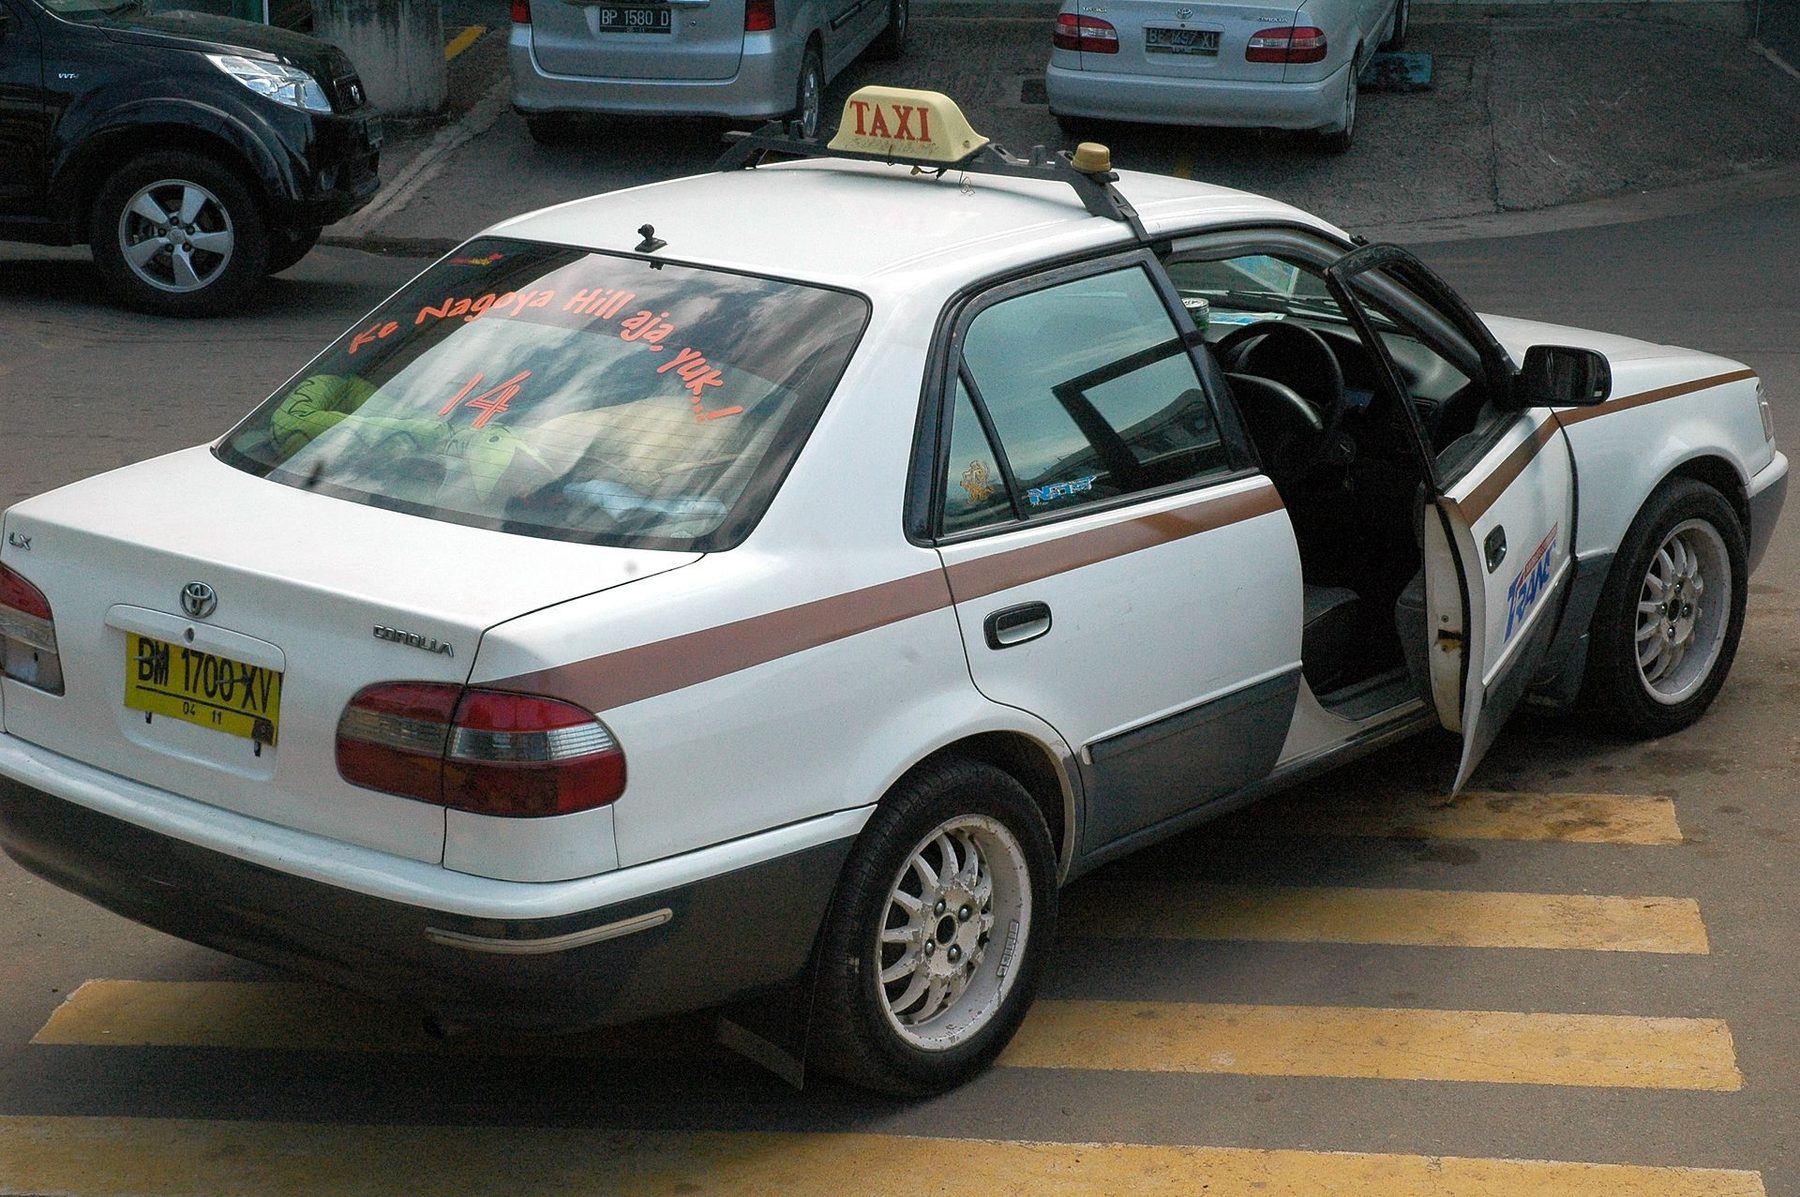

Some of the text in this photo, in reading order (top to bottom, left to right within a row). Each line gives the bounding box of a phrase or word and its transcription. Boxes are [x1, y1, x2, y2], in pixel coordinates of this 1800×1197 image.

[601, 9, 669, 26] BP 1580 D
[849, 100, 932, 143] TAXI
[349, 321, 399, 354] Ke
[414, 289, 555, 325] Nagoya
[562, 287, 635, 320] Hill
[438, 368, 533, 430] 14
[8, 531, 32, 551] LX
[373, 624, 455, 657] COROLLA
[137, 636, 273, 714] BM 1700 XV
[182, 701, 222, 725] 04 11
